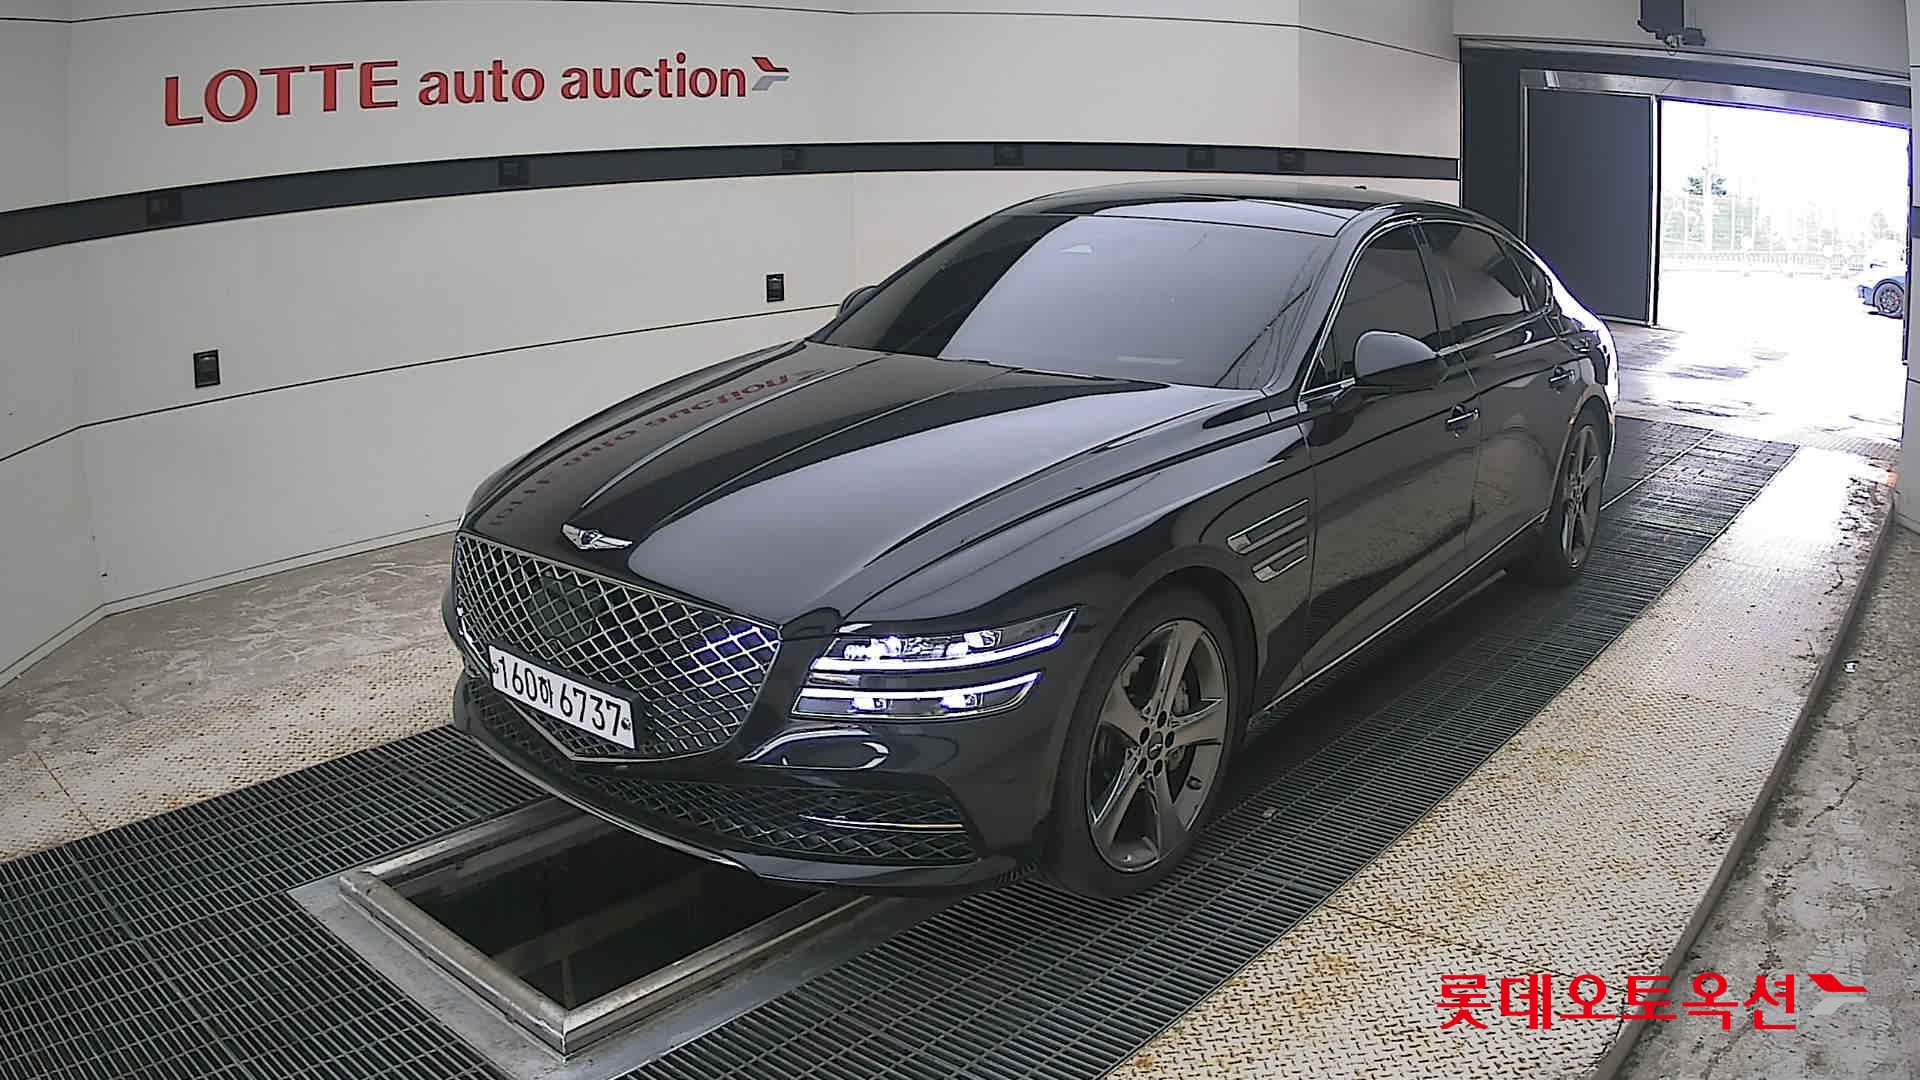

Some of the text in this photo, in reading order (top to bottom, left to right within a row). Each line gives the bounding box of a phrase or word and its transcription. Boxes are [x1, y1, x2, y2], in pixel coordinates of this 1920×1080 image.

[165, 52, 747, 126] LOTTE auto auction
[498, 656, 622, 737] 160하 6737
